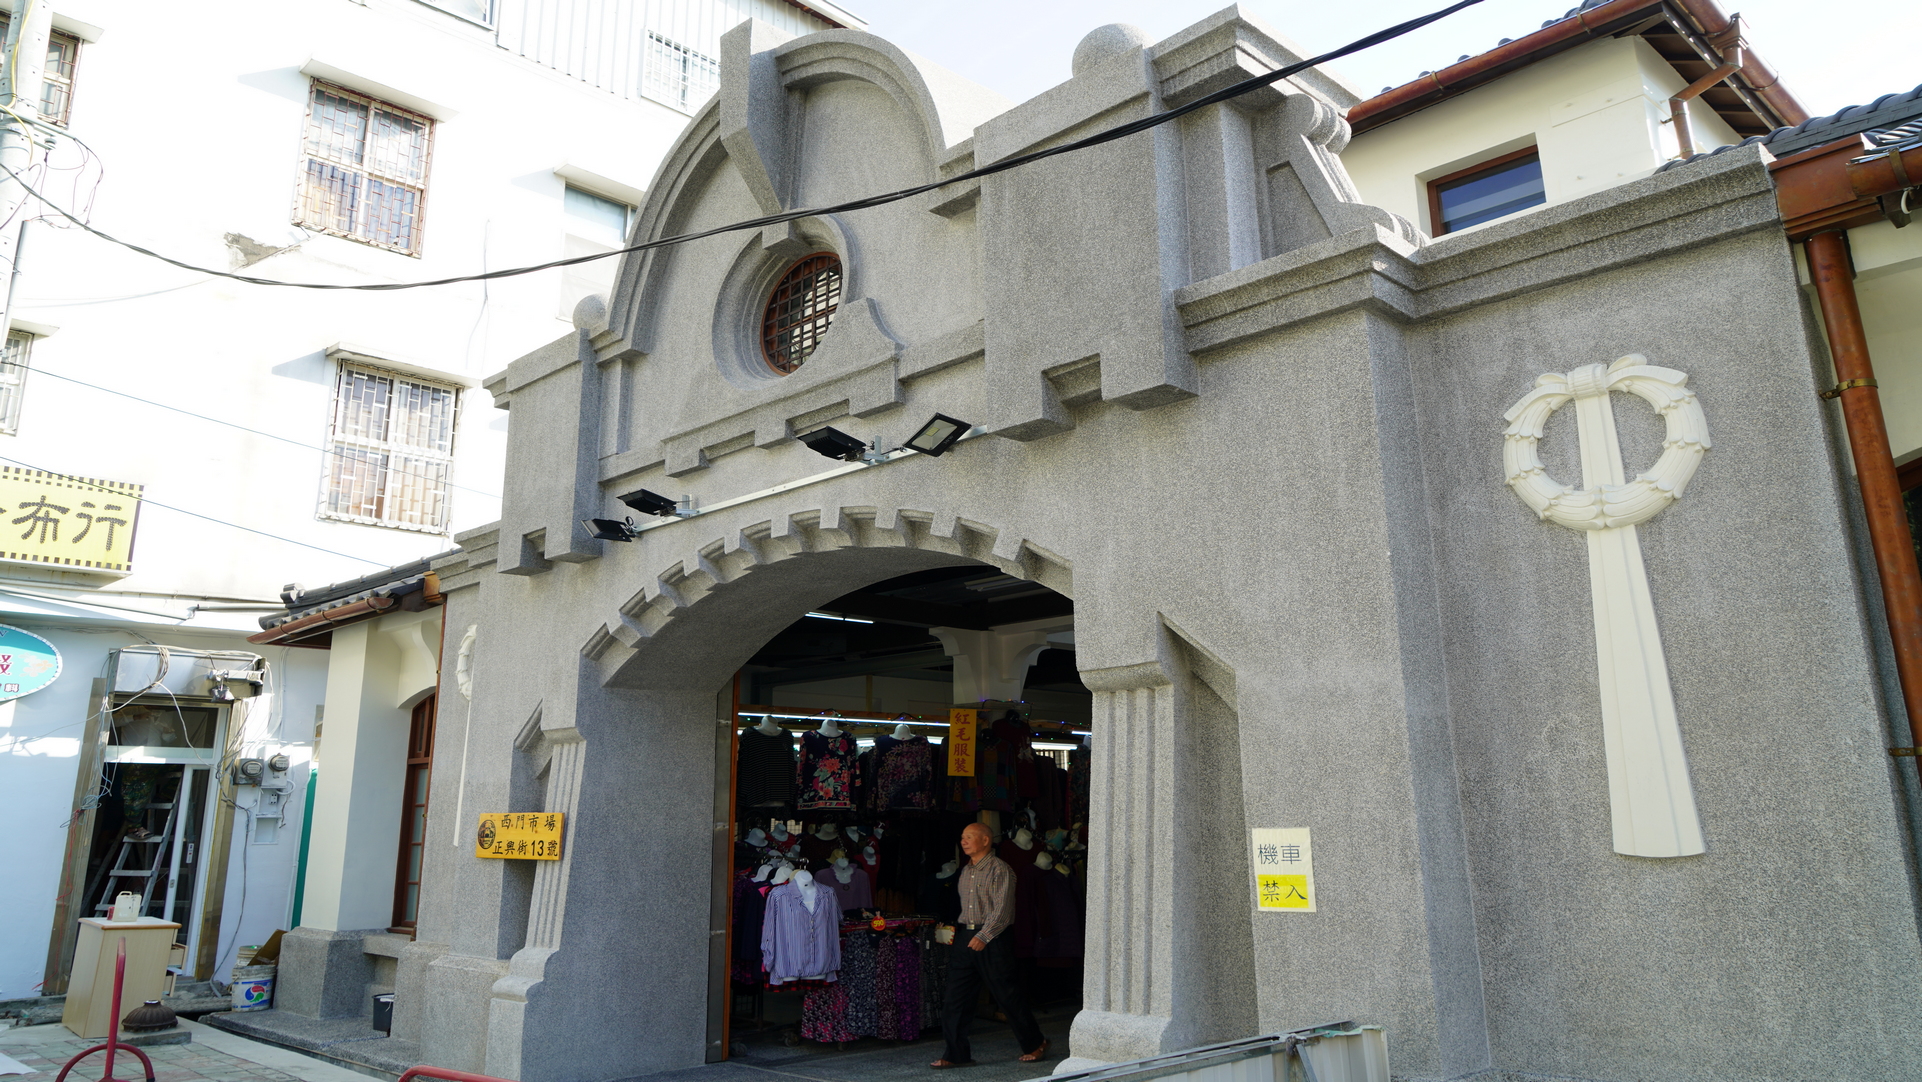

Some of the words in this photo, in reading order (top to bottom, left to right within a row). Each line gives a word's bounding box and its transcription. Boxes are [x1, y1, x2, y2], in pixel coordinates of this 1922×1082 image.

[953, 712, 971, 773] 紅毛服裝
[501, 814, 556, 832] 西門市場
[492, 840, 558, 857] 正興街13號
[1257, 844, 1302, 865] 機車
[1263, 880, 1308, 902] 禁入
